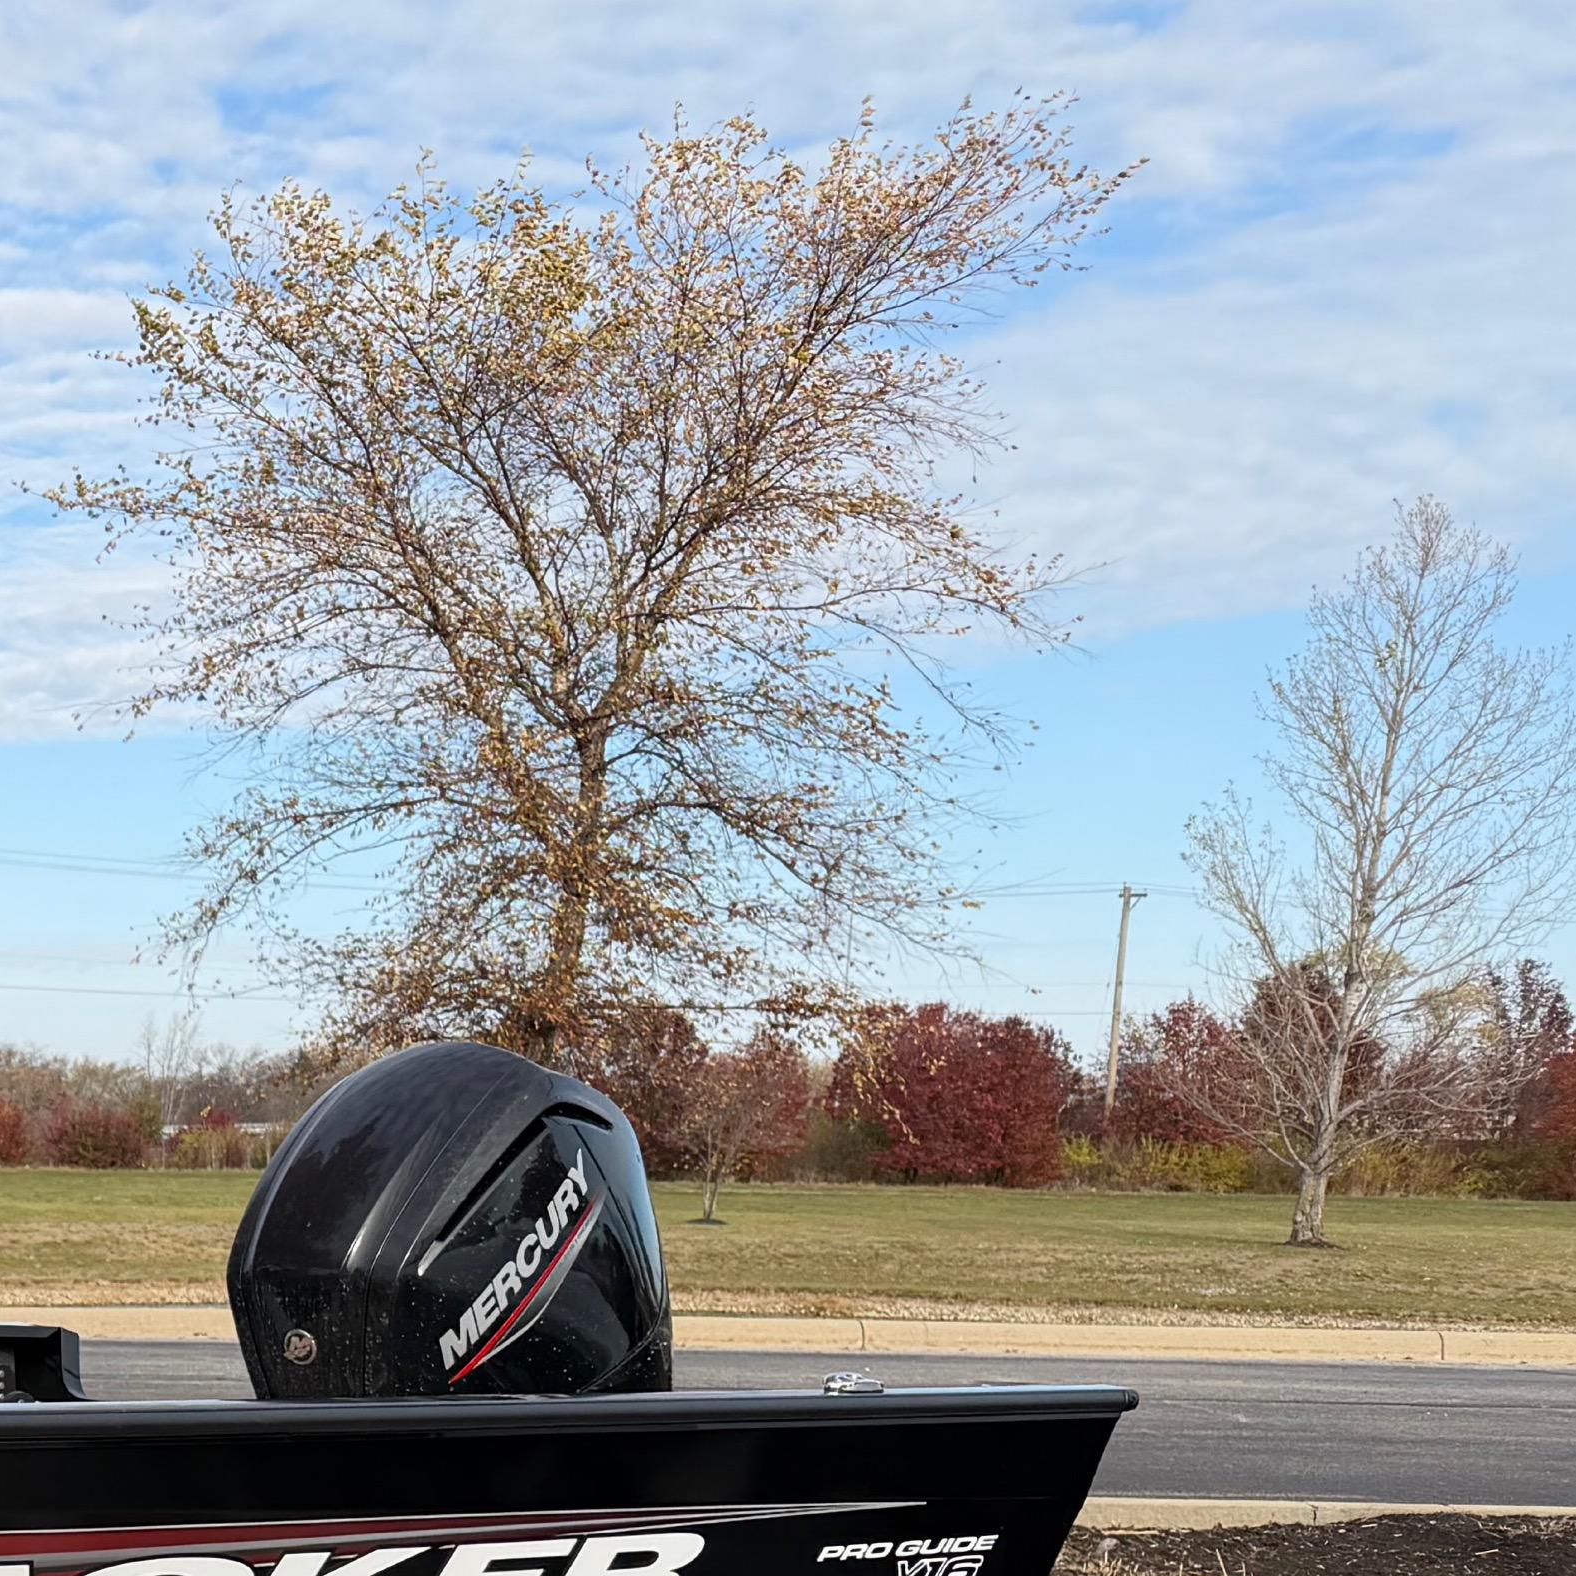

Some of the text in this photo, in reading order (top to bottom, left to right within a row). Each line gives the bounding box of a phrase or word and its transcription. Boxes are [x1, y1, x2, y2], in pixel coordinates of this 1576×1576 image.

[439, 1148, 588, 1370] MERCURY
[817, 1534, 999, 1562] PRO GUIDE
